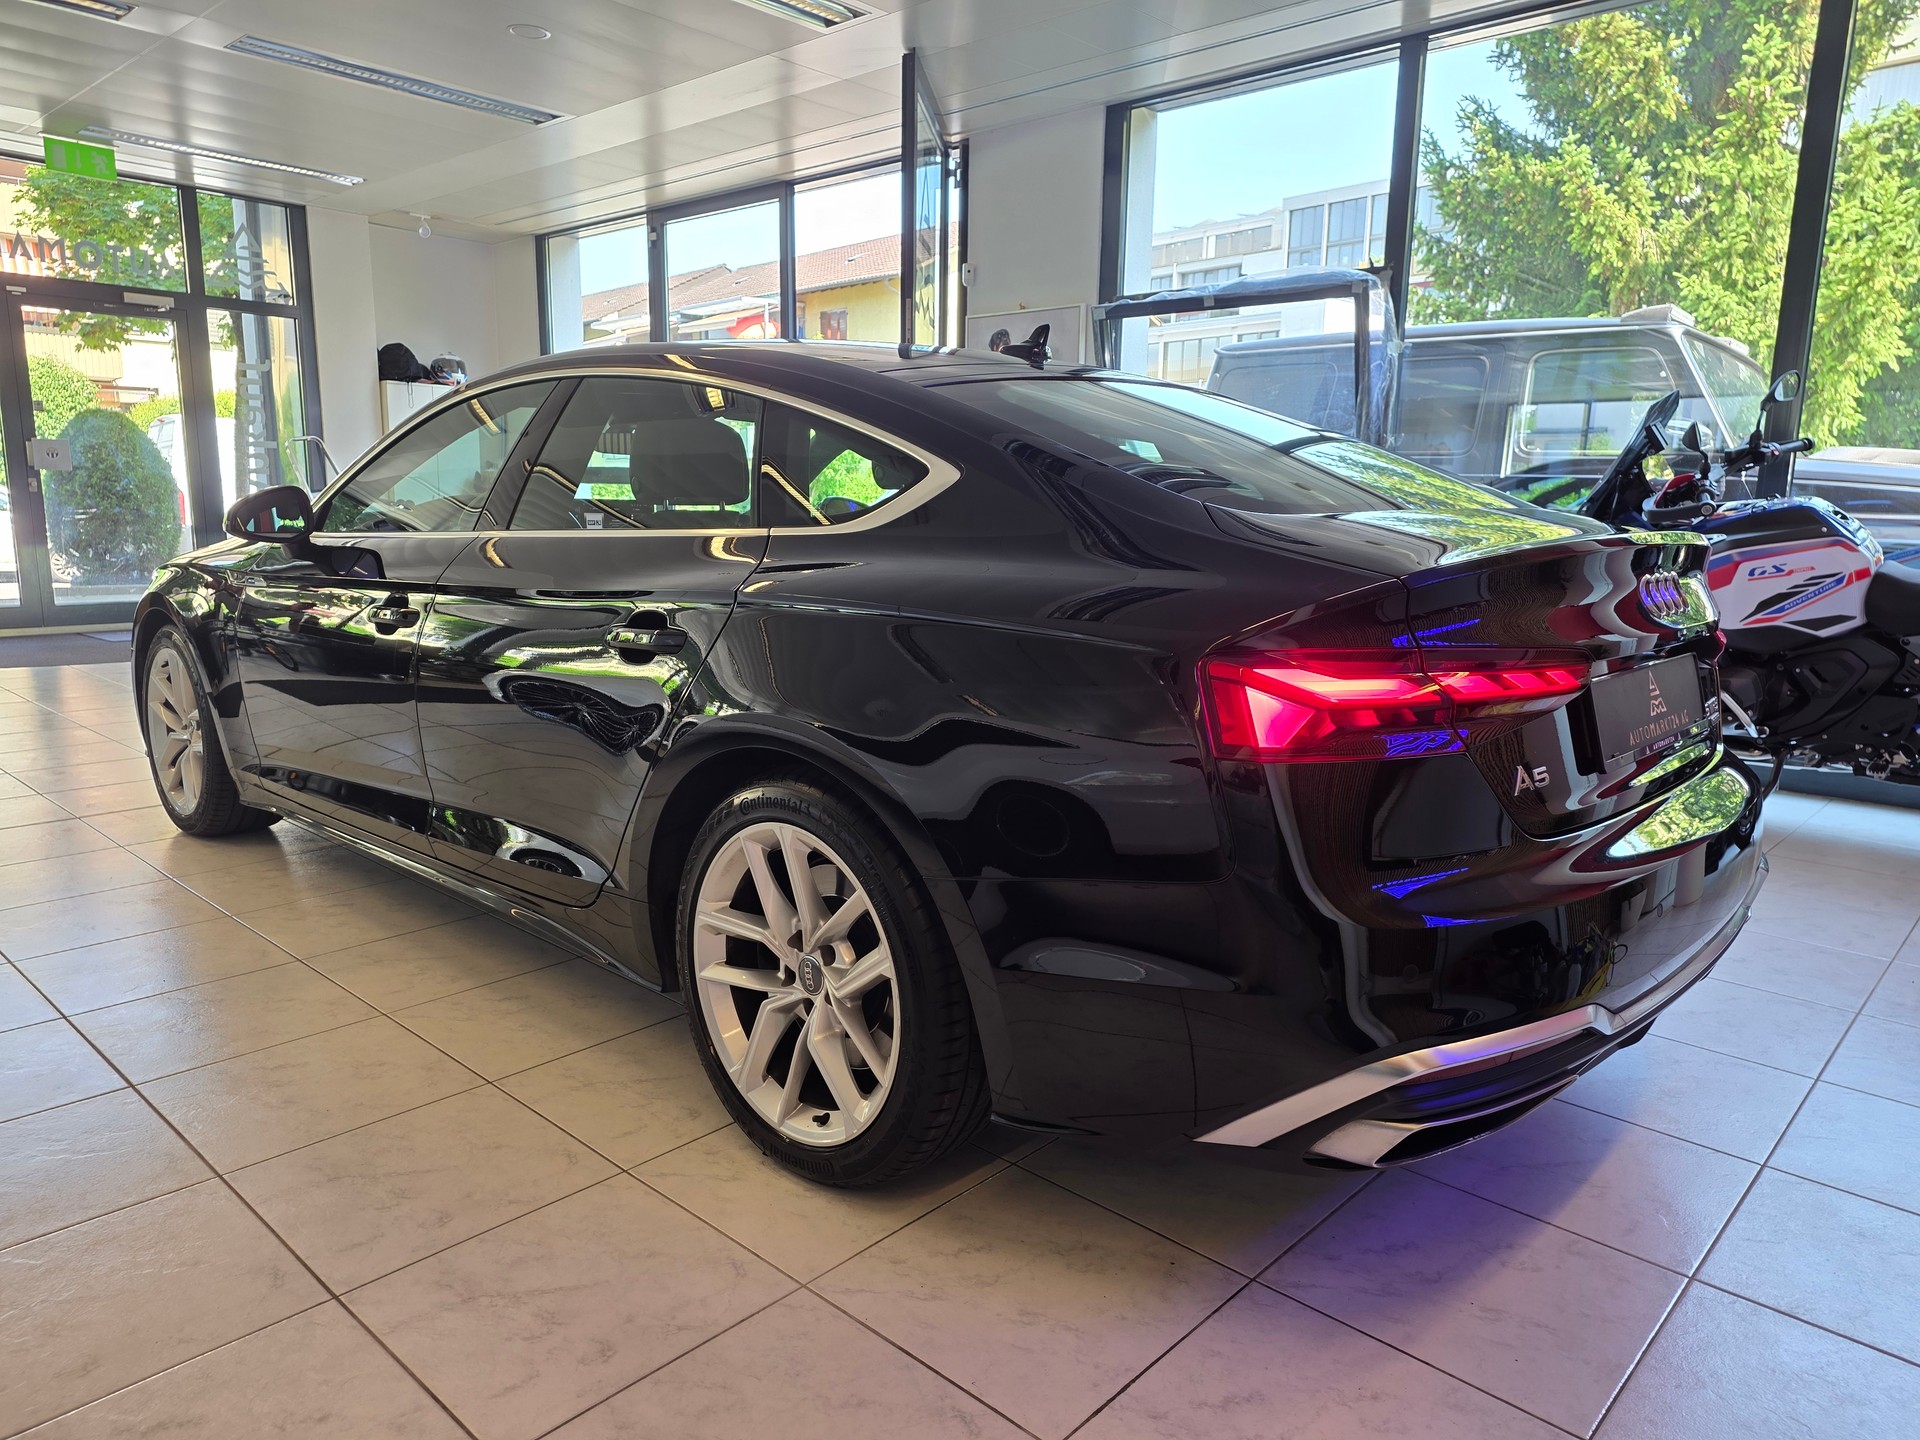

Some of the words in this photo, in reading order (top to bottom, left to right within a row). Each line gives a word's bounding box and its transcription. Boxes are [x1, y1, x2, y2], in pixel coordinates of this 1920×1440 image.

[1748, 563, 1787, 577] GS
[1784, 581, 1837, 610] ADVENTURE
[1629, 714, 1680, 746] AUTOMARKT24
[1681, 709, 1689, 724] AG
[1514, 764, 1550, 796] A5
[739, 793, 803, 816] Continental
